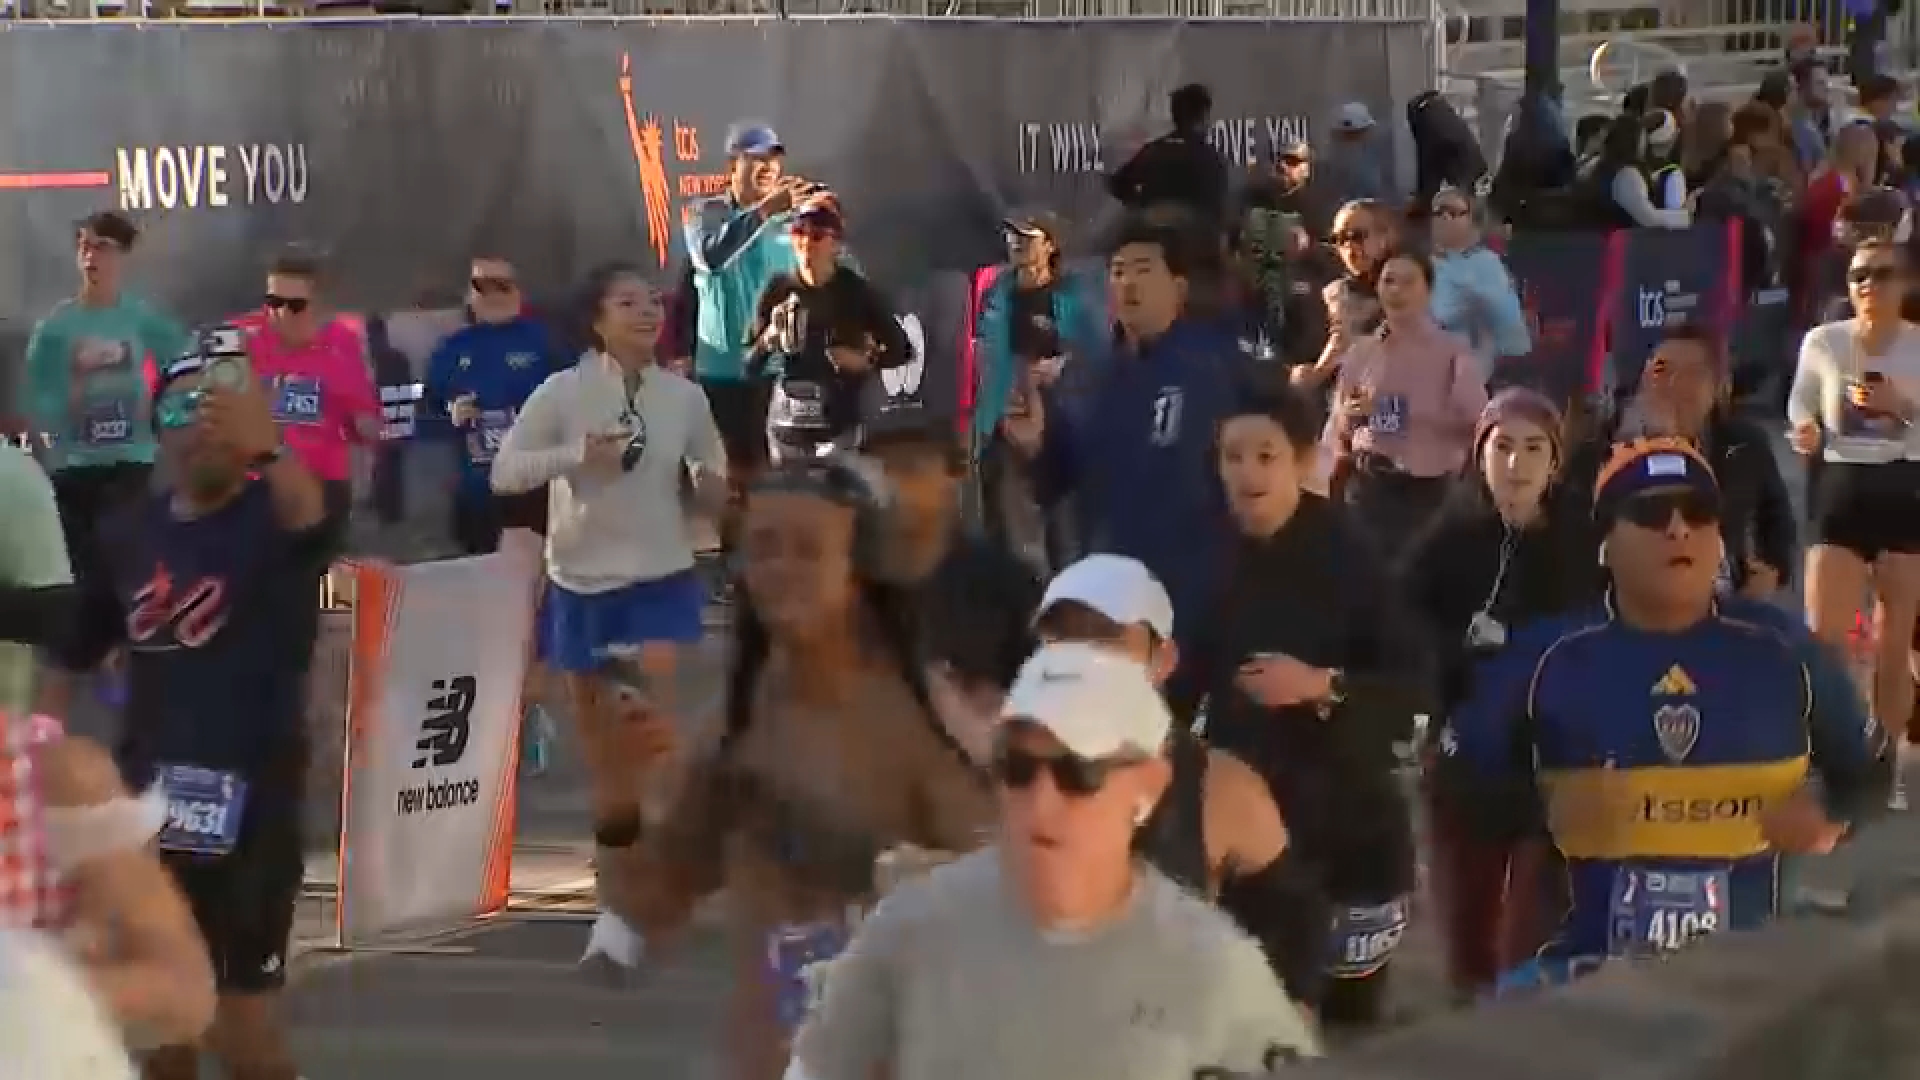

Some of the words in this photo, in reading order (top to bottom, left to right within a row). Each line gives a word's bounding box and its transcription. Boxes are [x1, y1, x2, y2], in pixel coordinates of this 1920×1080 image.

[1018, 123, 1041, 174] IT
[1049, 122, 1105, 173] WILL
[116, 145, 230, 211] MOVE
[238, 143, 307, 205] YOU
[397, 786, 425, 816] new
[425, 777, 479, 811] balance
[1629, 793, 1763, 824] tsson
